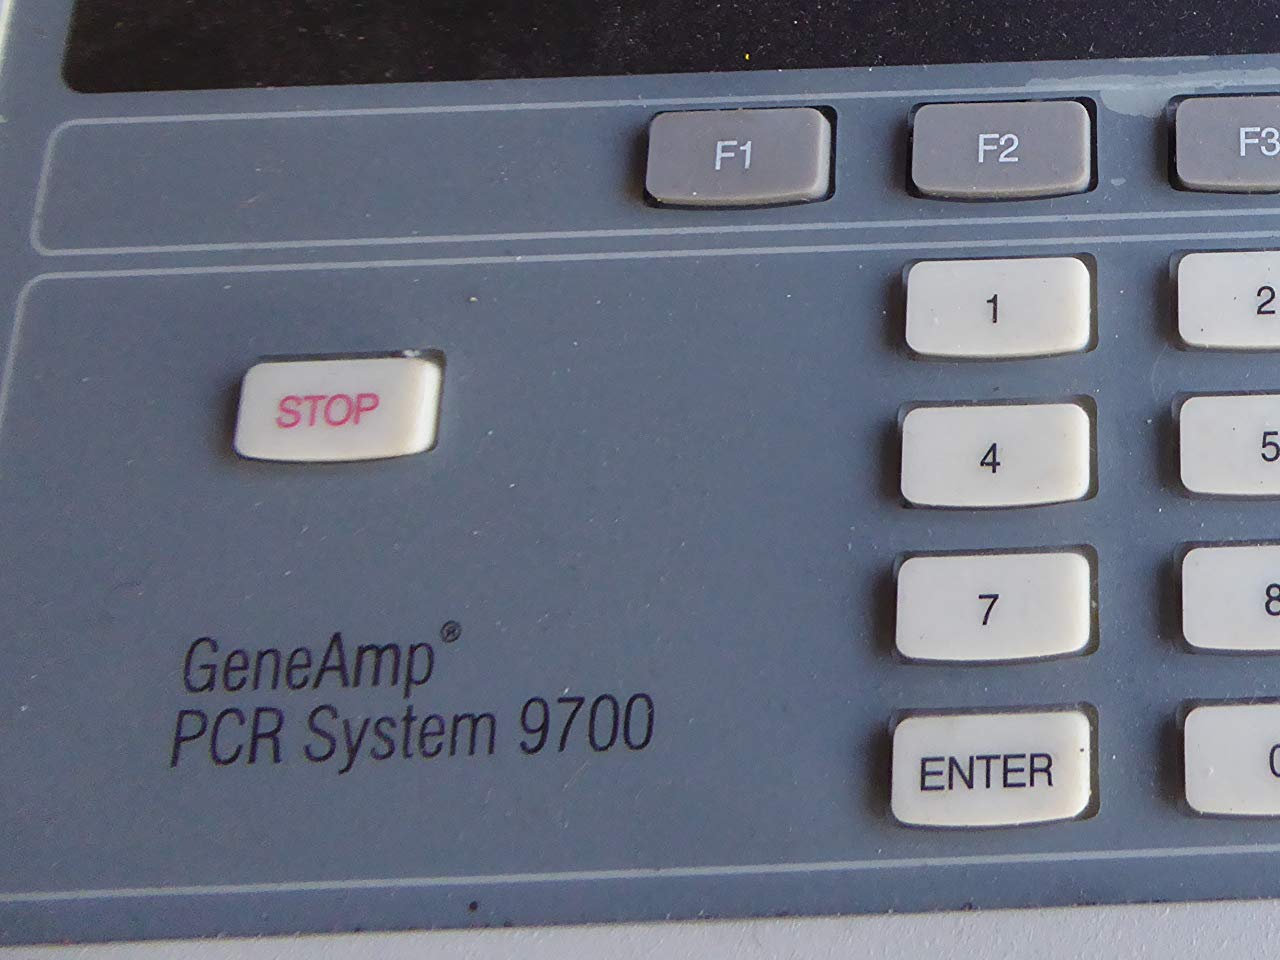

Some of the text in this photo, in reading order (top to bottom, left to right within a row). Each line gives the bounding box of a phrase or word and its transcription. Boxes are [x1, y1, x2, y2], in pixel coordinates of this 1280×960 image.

[714, 140, 752, 171] F1
[977, 133, 1020, 164] F2
[985, 293, 999, 324] 1
[1255, 285, 1277, 316] 2
[276, 392, 380, 428] STOP
[979, 443, 1002, 474] 4
[977, 594, 1000, 626] 7
[170, 692, 655, 775] PCR System 9700
[919, 751, 1055, 792] ENTER
